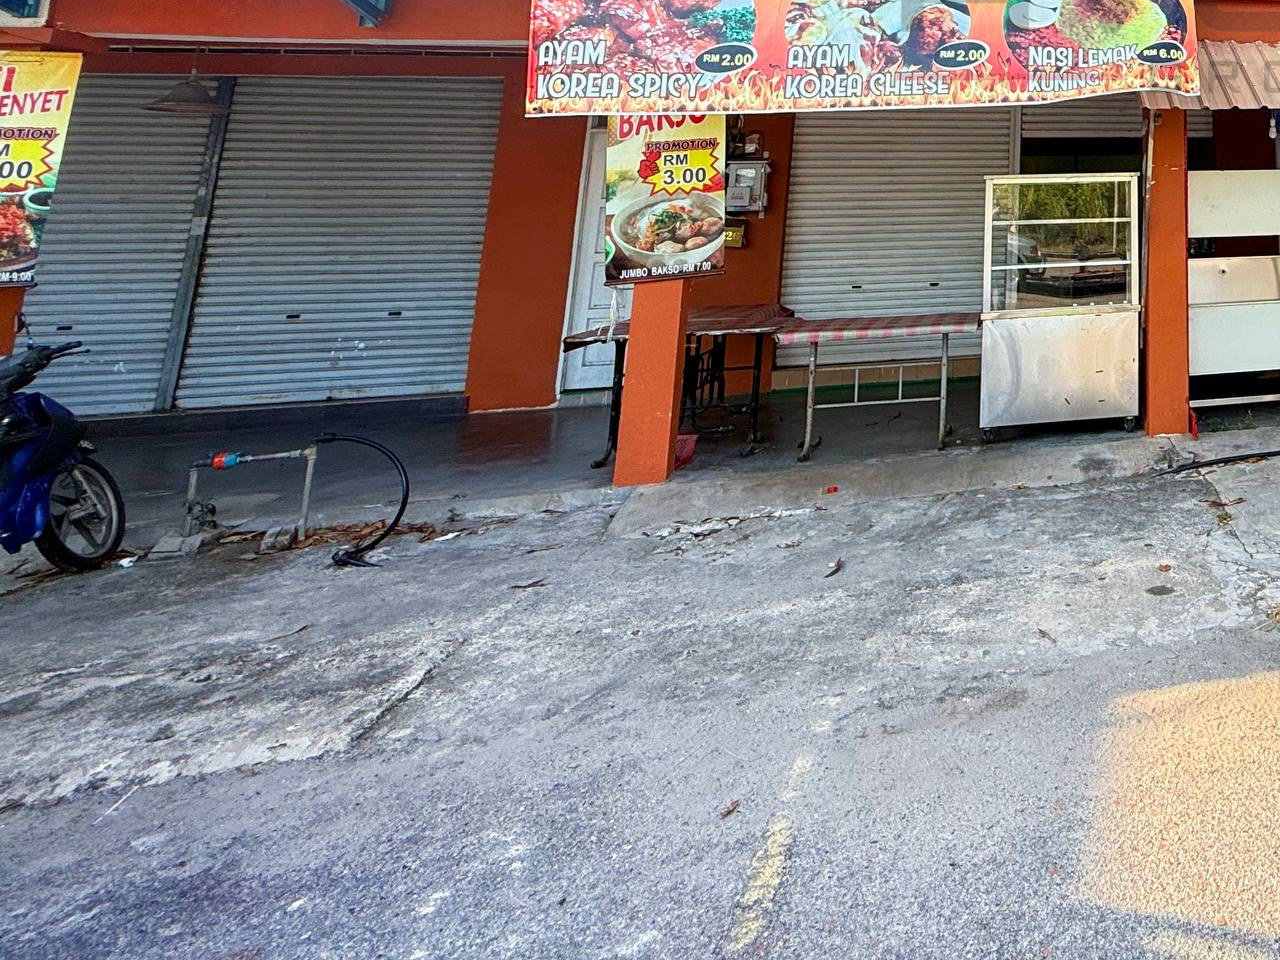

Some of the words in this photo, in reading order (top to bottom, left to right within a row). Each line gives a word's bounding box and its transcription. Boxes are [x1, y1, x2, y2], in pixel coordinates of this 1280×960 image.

[538, 39, 607, 66] AYAM
[703, 54, 720, 62] RM
[721, 53, 752, 66] 2.00
[787, 44, 851, 69] AYAM
[940, 50, 955, 59] RM
[956, 49, 985, 61] 2.00
[1028, 46, 1073, 67] NASI
[1078, 43, 1138, 68] LEMAK
[1143, 49, 1158, 57] RM
[1159, 48, 1183, 60] 6.00
[535, 72, 620, 100] KOREA
[628, 72, 702, 100] SPICY
[784, 73, 863, 100] KOREA
[870, 71, 950, 96] CHEESE
[1028, 71, 1100, 93] KUNING
[0, 128, 55, 139] OTION
[646, 139, 716, 152] PROMOTION
[663, 154, 688, 166] RM
[663, 168, 706, 185] 3.00
[620, 269, 648, 279] JUMBO
[651, 265, 680, 276] BAKSO
[683, 263, 695, 272] RM
[696, 261, 711, 271] 7.00
